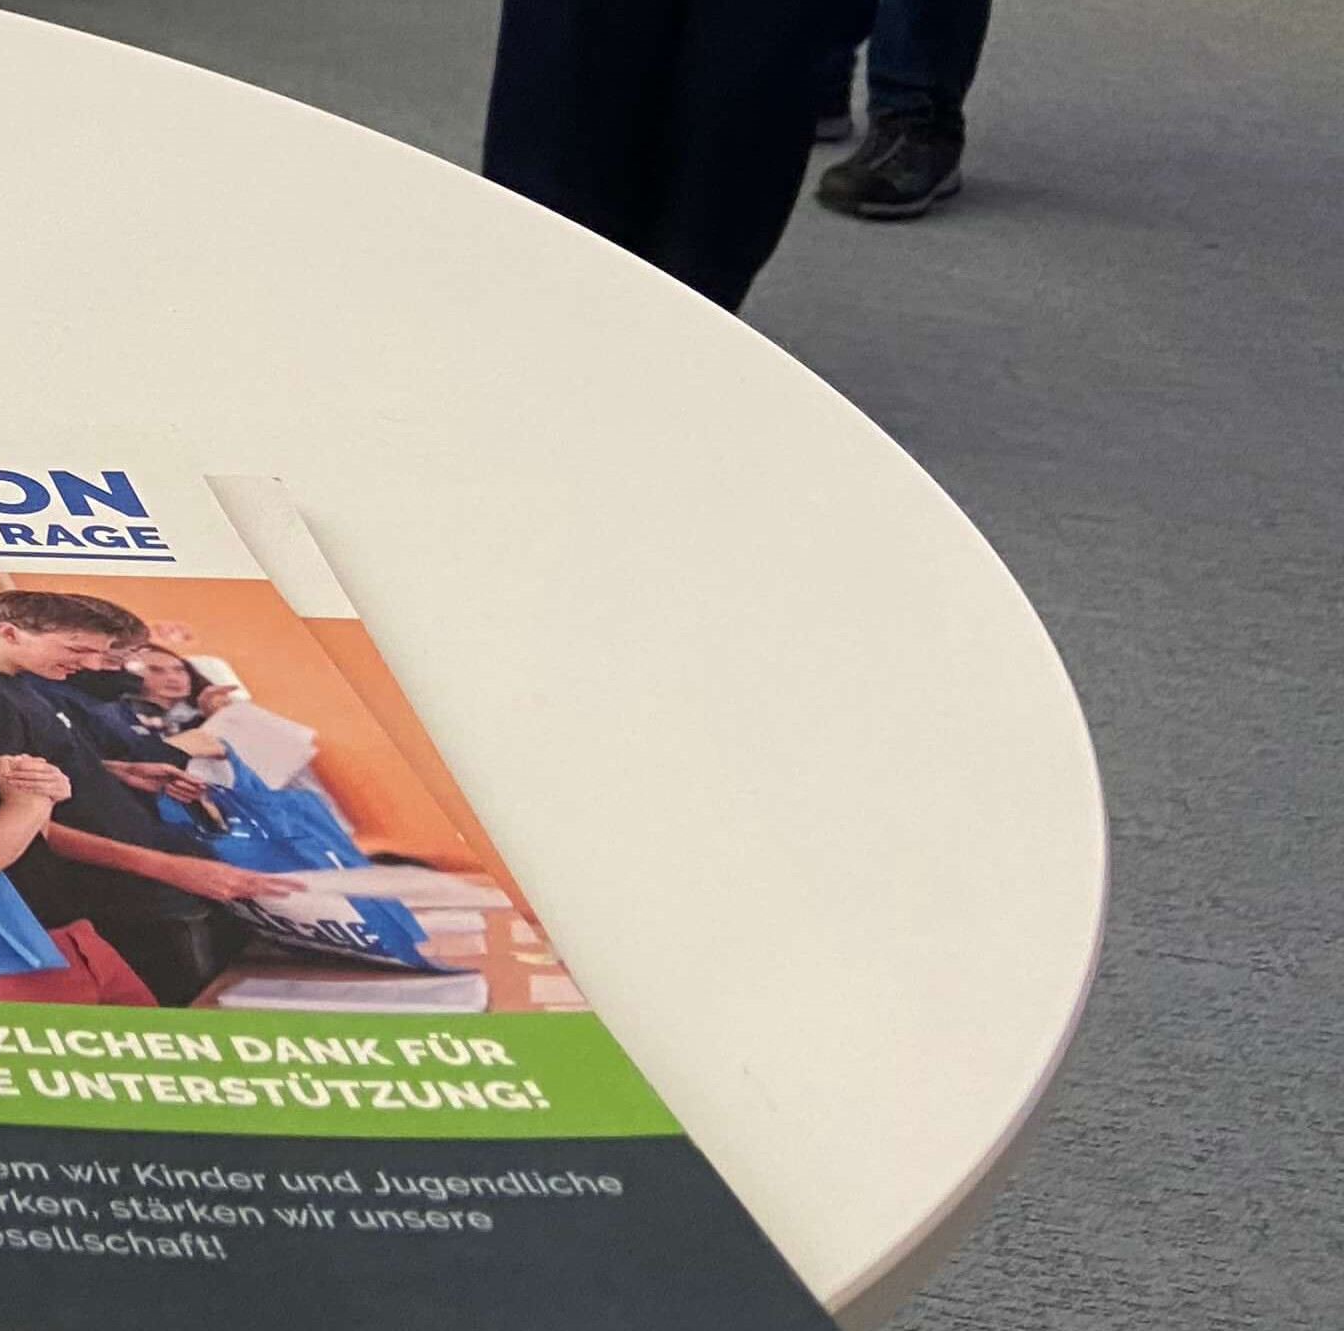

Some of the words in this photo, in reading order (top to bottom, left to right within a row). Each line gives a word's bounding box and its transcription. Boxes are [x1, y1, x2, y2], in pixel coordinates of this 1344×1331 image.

[230, 1035, 393, 1066] DANK
[396, 1031, 516, 1067] FÜR
[28, 1068, 551, 1111] UNTERSTÜTZUNG!
[59, 1161, 119, 1185] wir
[133, 1162, 266, 1191] Kinder
[280, 1170, 361, 1196] und
[374, 1170, 623, 1200] Jugendliche
[110, 1195, 264, 1228] stärken
[274, 1205, 336, 1229] wir
[350, 1209, 493, 1231] unsere
